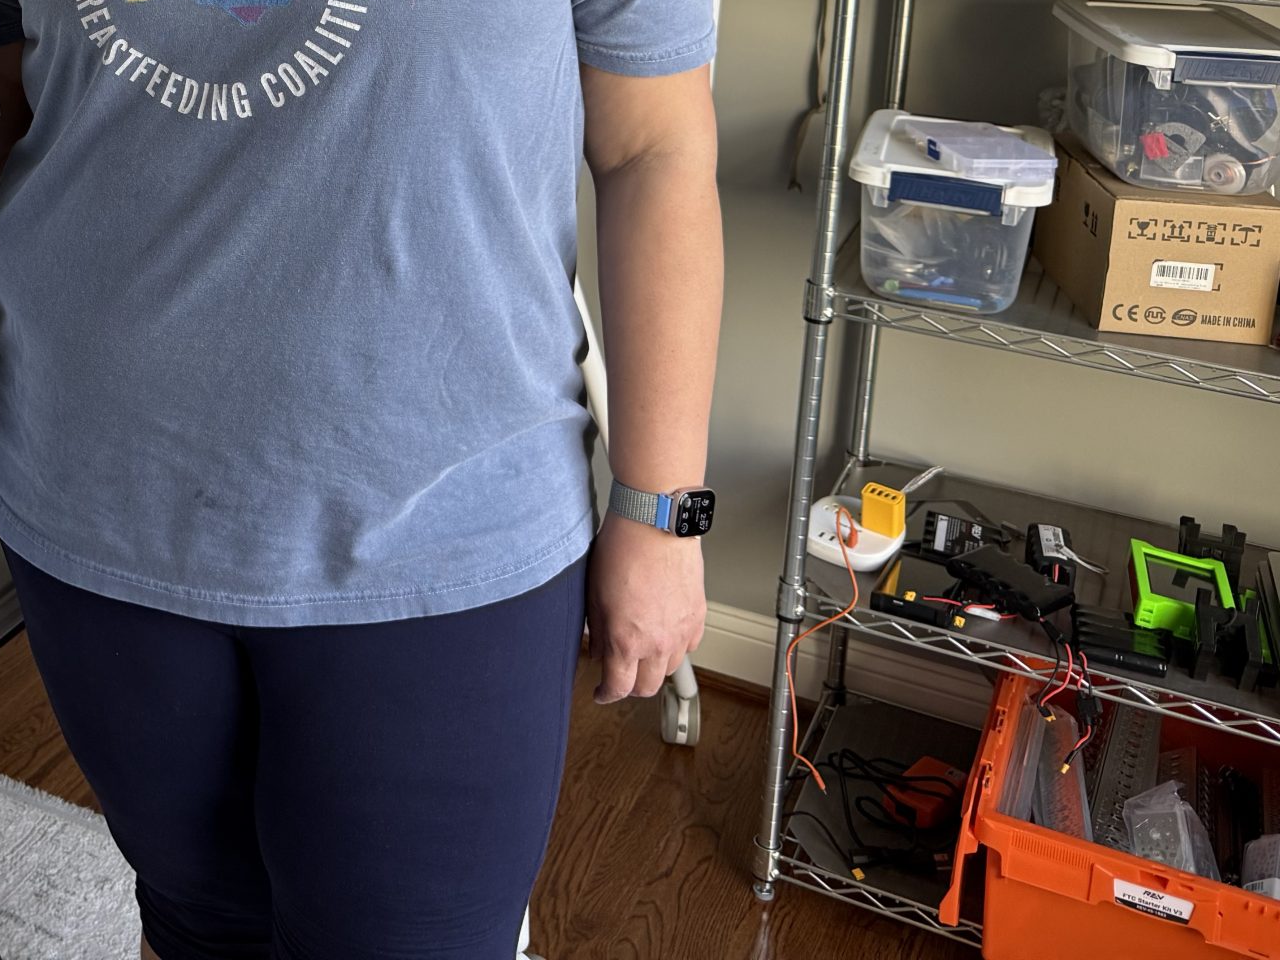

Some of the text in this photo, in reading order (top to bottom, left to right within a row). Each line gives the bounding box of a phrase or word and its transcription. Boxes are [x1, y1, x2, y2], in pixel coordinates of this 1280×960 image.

[1201, 314, 1256, 328] MADE IN CHINA
[1122, 892, 1183, 916] FTC Starter Kit V3
